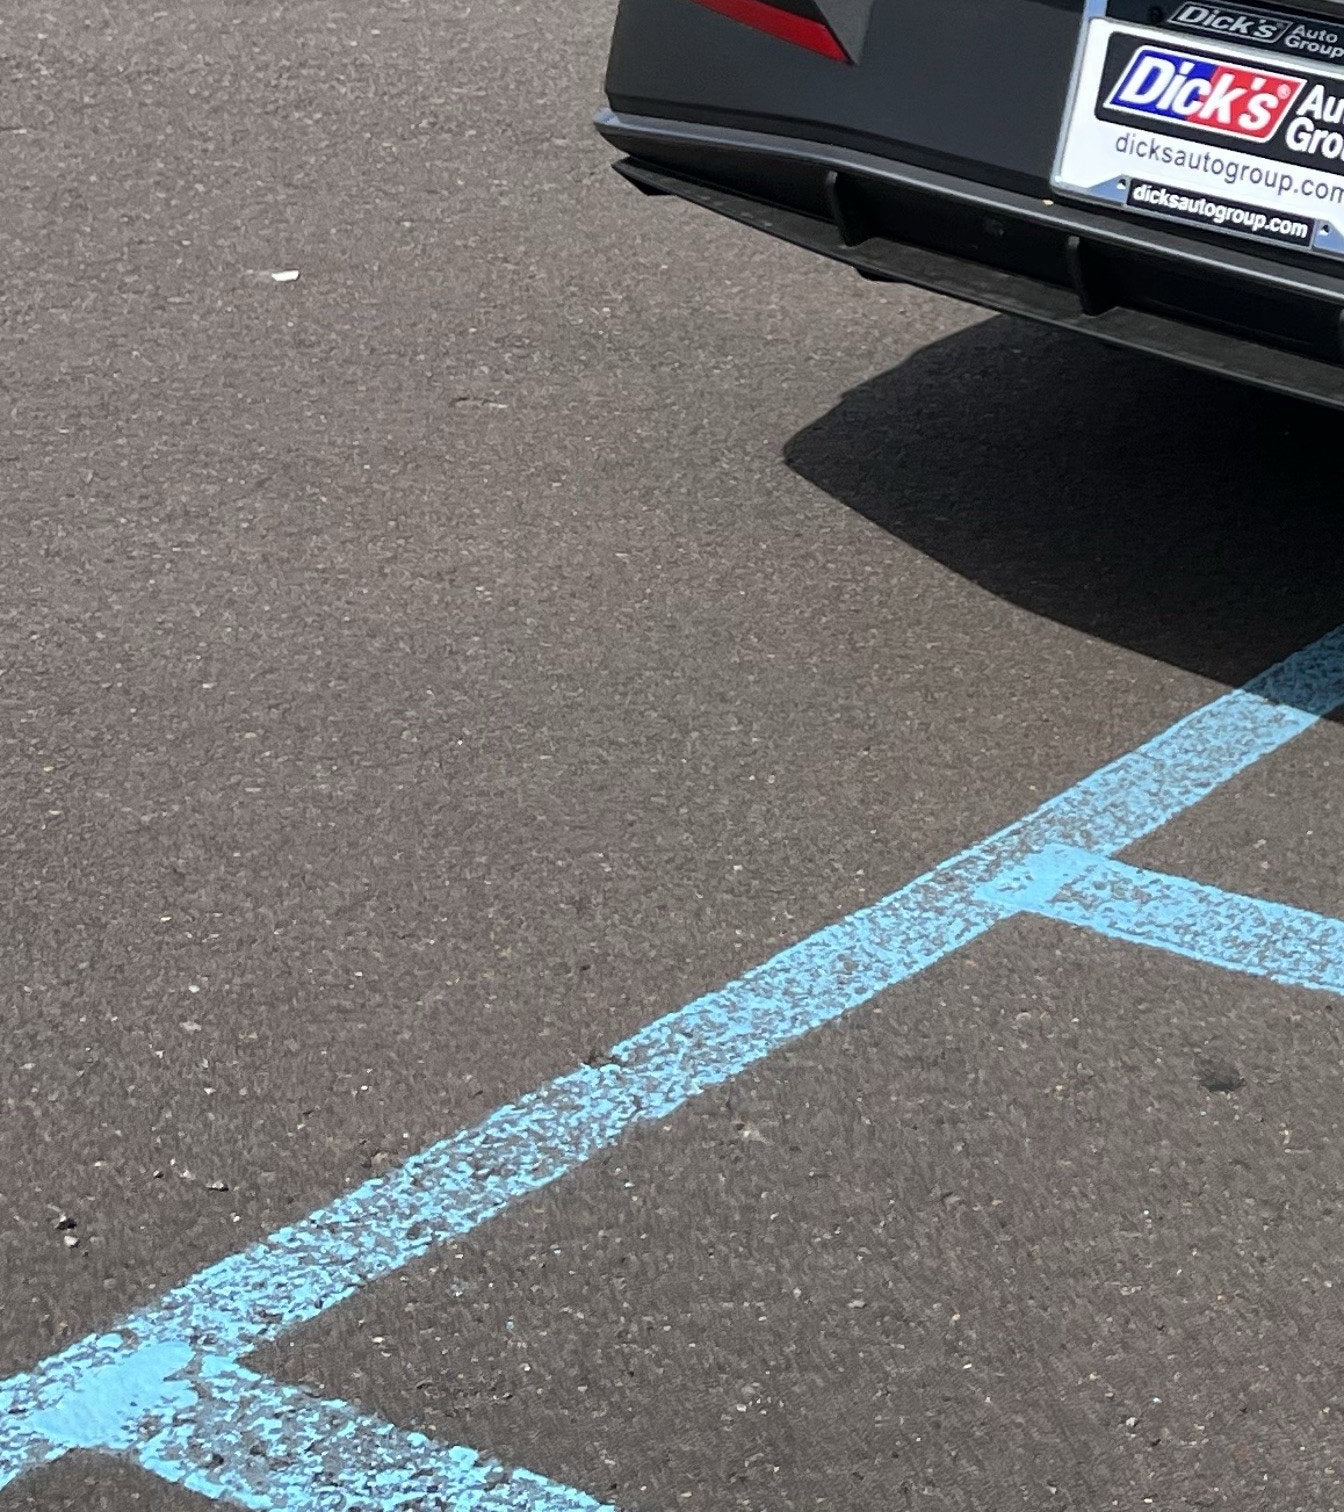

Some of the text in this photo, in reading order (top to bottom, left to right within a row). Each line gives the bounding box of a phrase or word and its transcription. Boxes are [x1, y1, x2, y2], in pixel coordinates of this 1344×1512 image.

[1177, 5, 1338, 44] Dick's Auto
[1284, 34, 1344, 59] Group
[1118, 55, 1279, 131] Dick's
[1132, 184, 1308, 239] dicksautogroup.com
